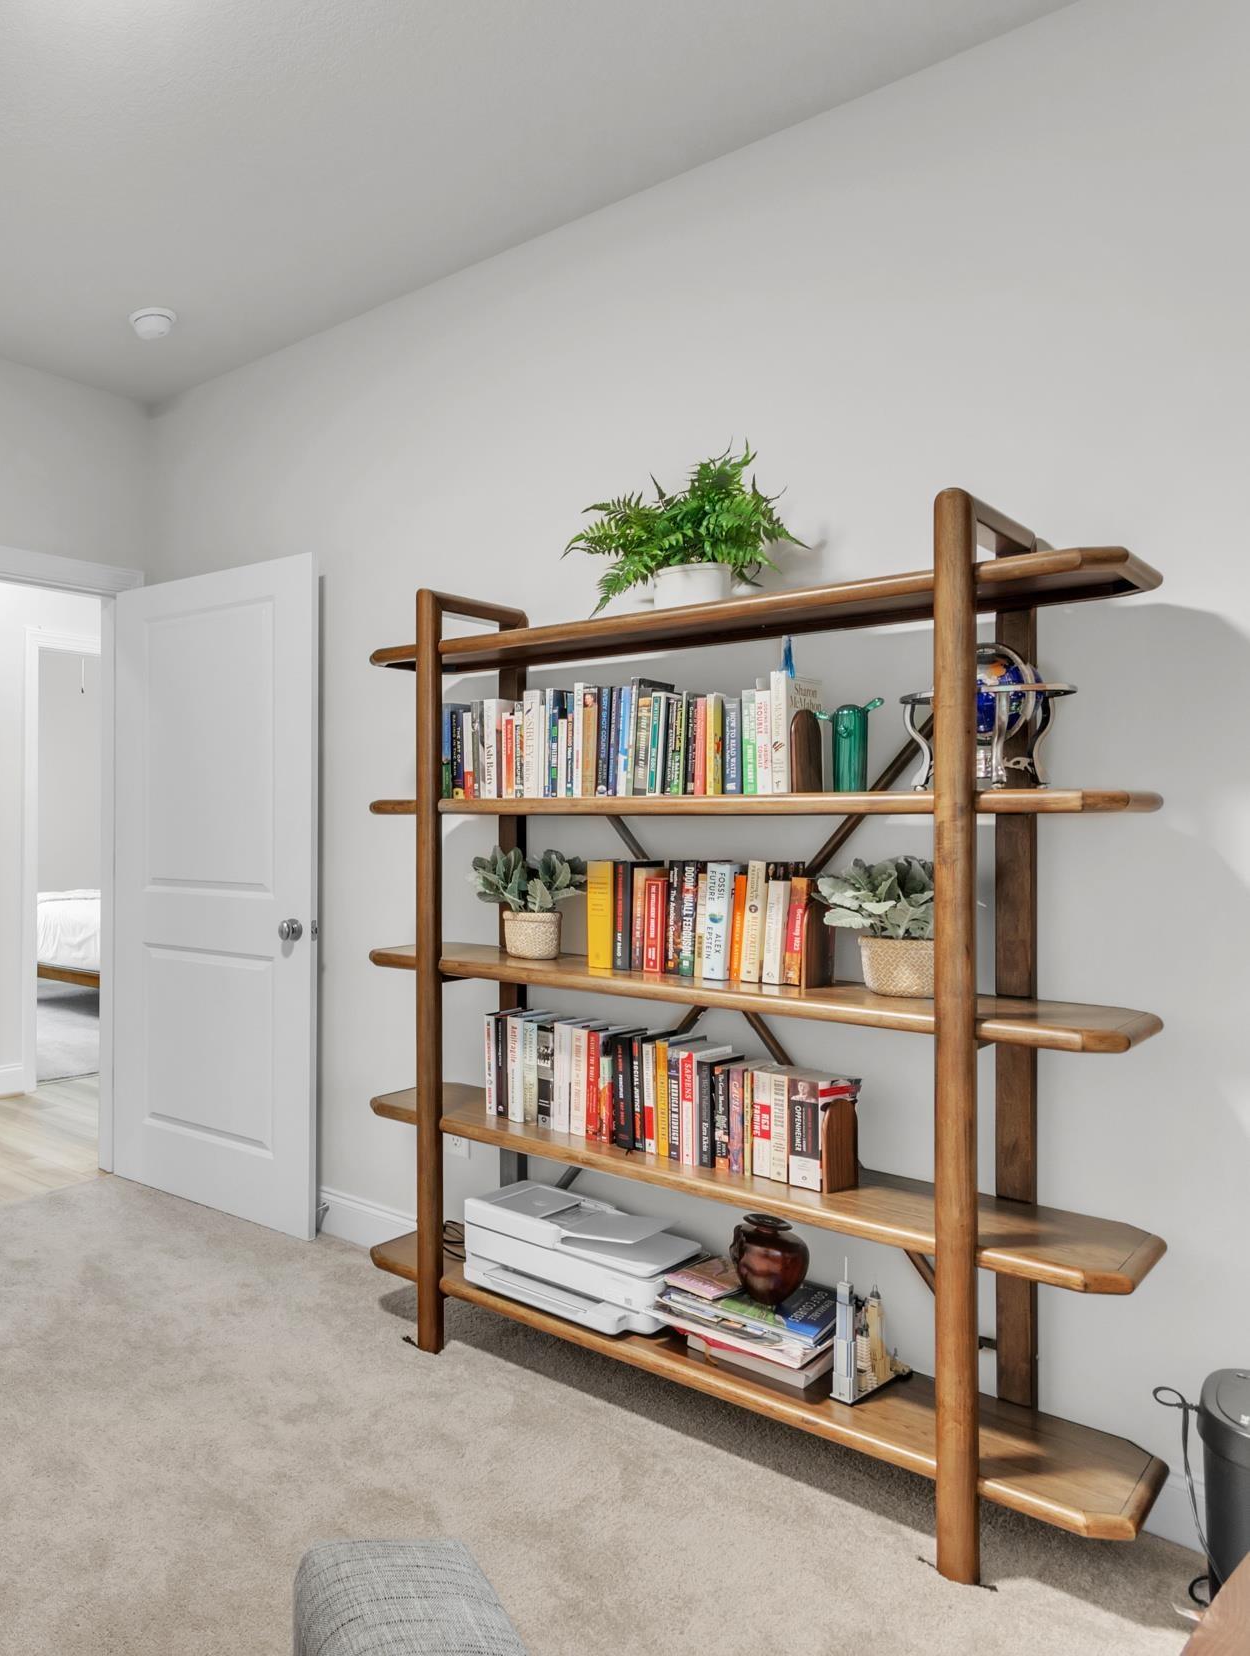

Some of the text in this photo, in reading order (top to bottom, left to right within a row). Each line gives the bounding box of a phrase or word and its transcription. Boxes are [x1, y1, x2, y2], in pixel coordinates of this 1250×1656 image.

[794, 683, 818, 698] Sharon
[526, 721, 534, 759] SIBLEY
[730, 729, 736, 738] TO
[456, 754, 461, 763] OF
[486, 762, 494, 785] Barty
[708, 870, 717, 901] FUTURE
[717, 872, 726, 901] FOSSIL
[682, 866, 695, 957] DOOM NIALL FERGUSON
[792, 908, 803, 936] Germany
[668, 926, 676, 959] Generation
[705, 926, 714, 960] EPSTEIN
[713, 933, 722, 954] ALEX
[509, 1025, 518, 1064] Antifragile
[684, 1063, 692, 1100] SAPIENS
[671, 1113, 679, 1145] MIDNIGHT
[753, 1104, 761, 1137] FAMINE
[761, 1113, 770, 1131] RED
[794, 1105, 802, 1152] OPPENHEIMER
